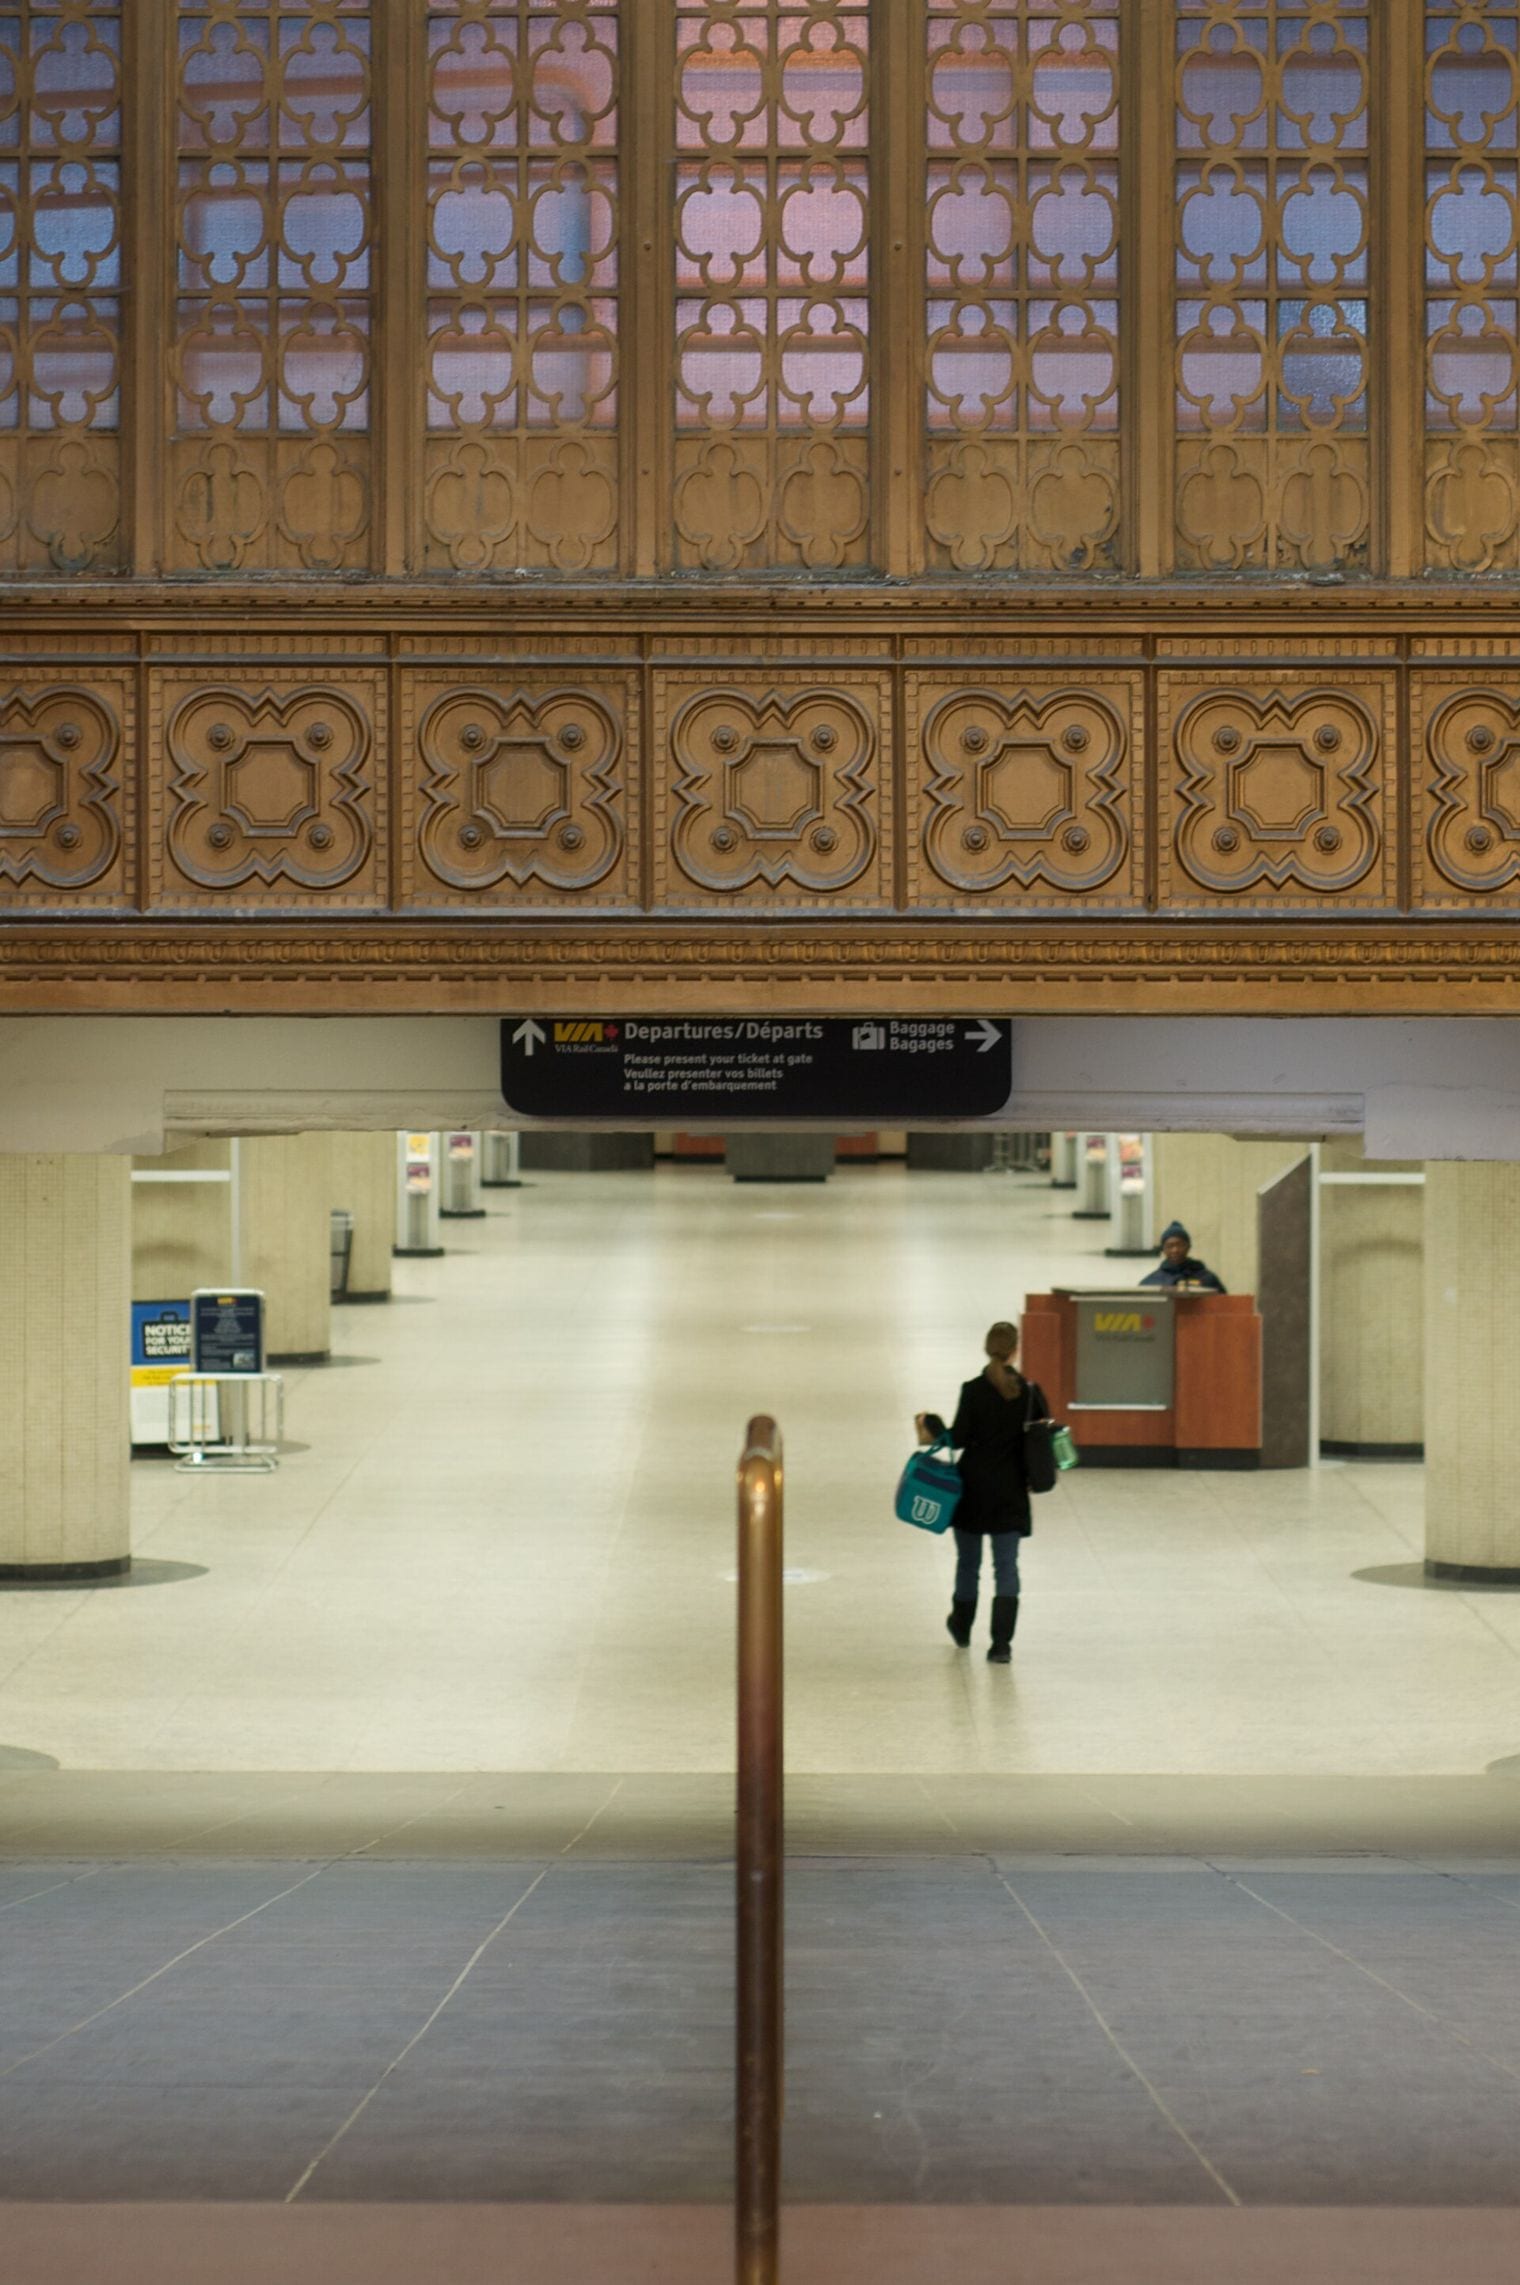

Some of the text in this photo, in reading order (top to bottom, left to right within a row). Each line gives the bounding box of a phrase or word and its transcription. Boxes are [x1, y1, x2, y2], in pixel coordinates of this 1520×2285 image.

[554, 1022, 603, 1042] VIA
[625, 1022, 824, 1042] Departures/Départs
[890, 1021, 955, 1037] Baggage
[890, 1037, 954, 1053] Bagages
[624, 1053, 813, 1066] Please present your ticket at gate
[667, 1068, 722, 1081] presenter
[725, 1070, 745, 1079] vos
[747, 1068, 784, 1079] billets
[633, 1081, 645, 1091] la
[647, 1081, 679, 1093] porte
[146, 1345, 190, 1355] SECURIT
